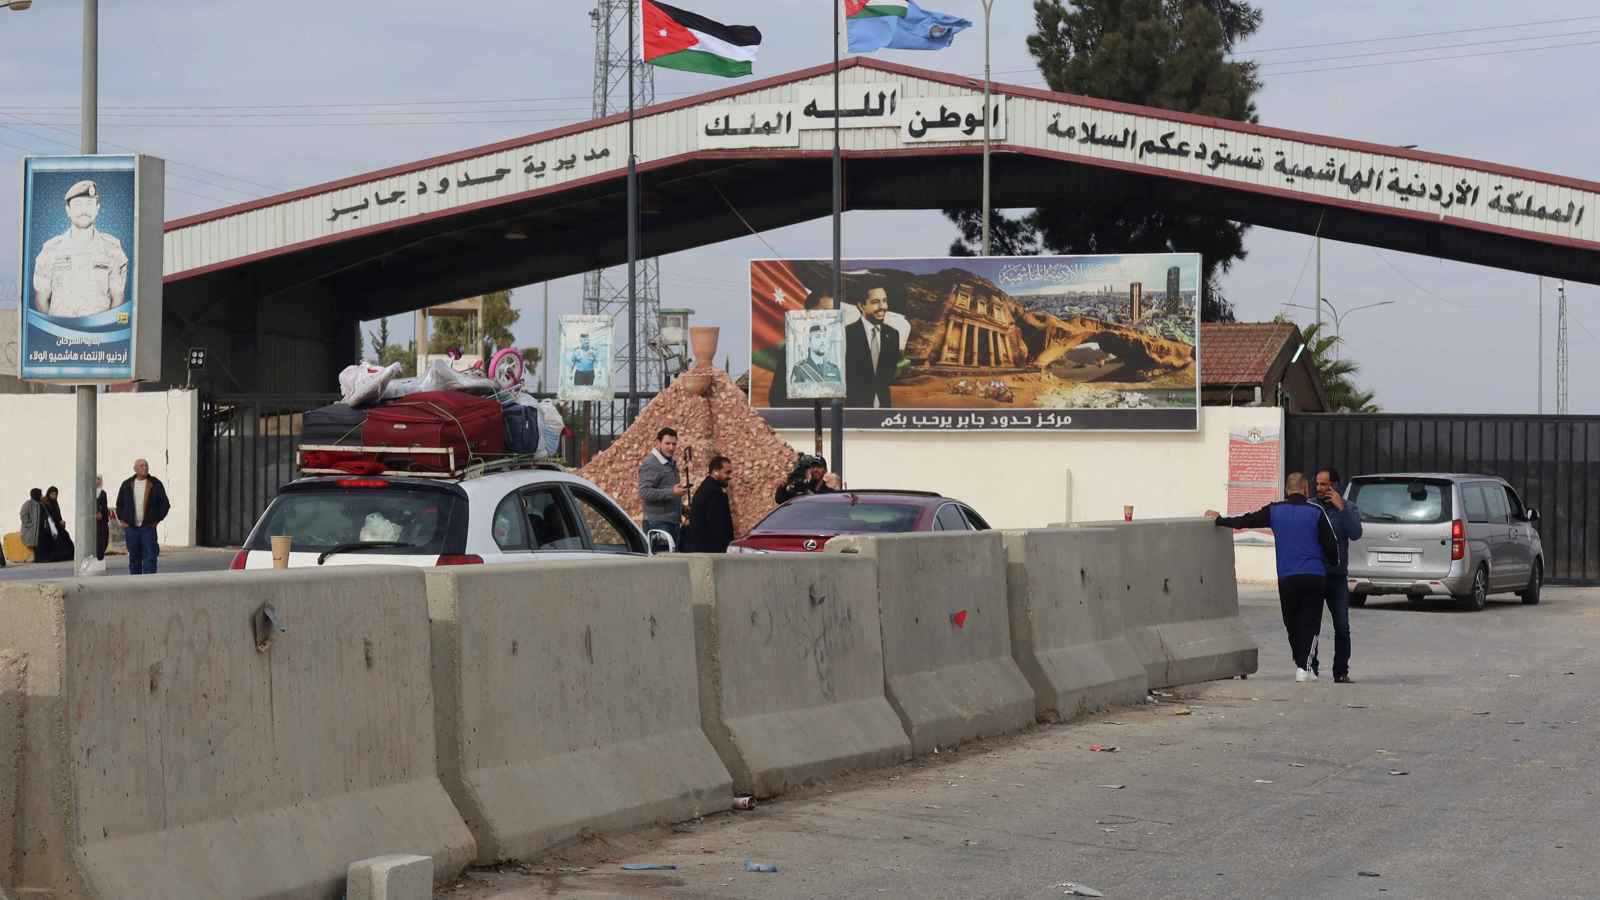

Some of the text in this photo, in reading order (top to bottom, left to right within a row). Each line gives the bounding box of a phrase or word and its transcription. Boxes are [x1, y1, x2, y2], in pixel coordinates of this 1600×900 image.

[803, 89, 897, 118] الله
[907, 103, 1000, 138] الوطن
[704, 111, 792, 137] الملك
[1046, 111, 1138, 151] السلامة
[1138, 131, 1265, 170] تستودعكم
[325, 146, 611, 222] مديرية حدود جابر
[1273, 149, 1384, 194] الهاشمية
[1488, 184, 1585, 227] المملكة
[29, 350, 48, 363] الولاء
[48, 349, 79, 363] هاشميو
[880, 412, 1073, 428] مركز حدود جابر يرحب بكم
